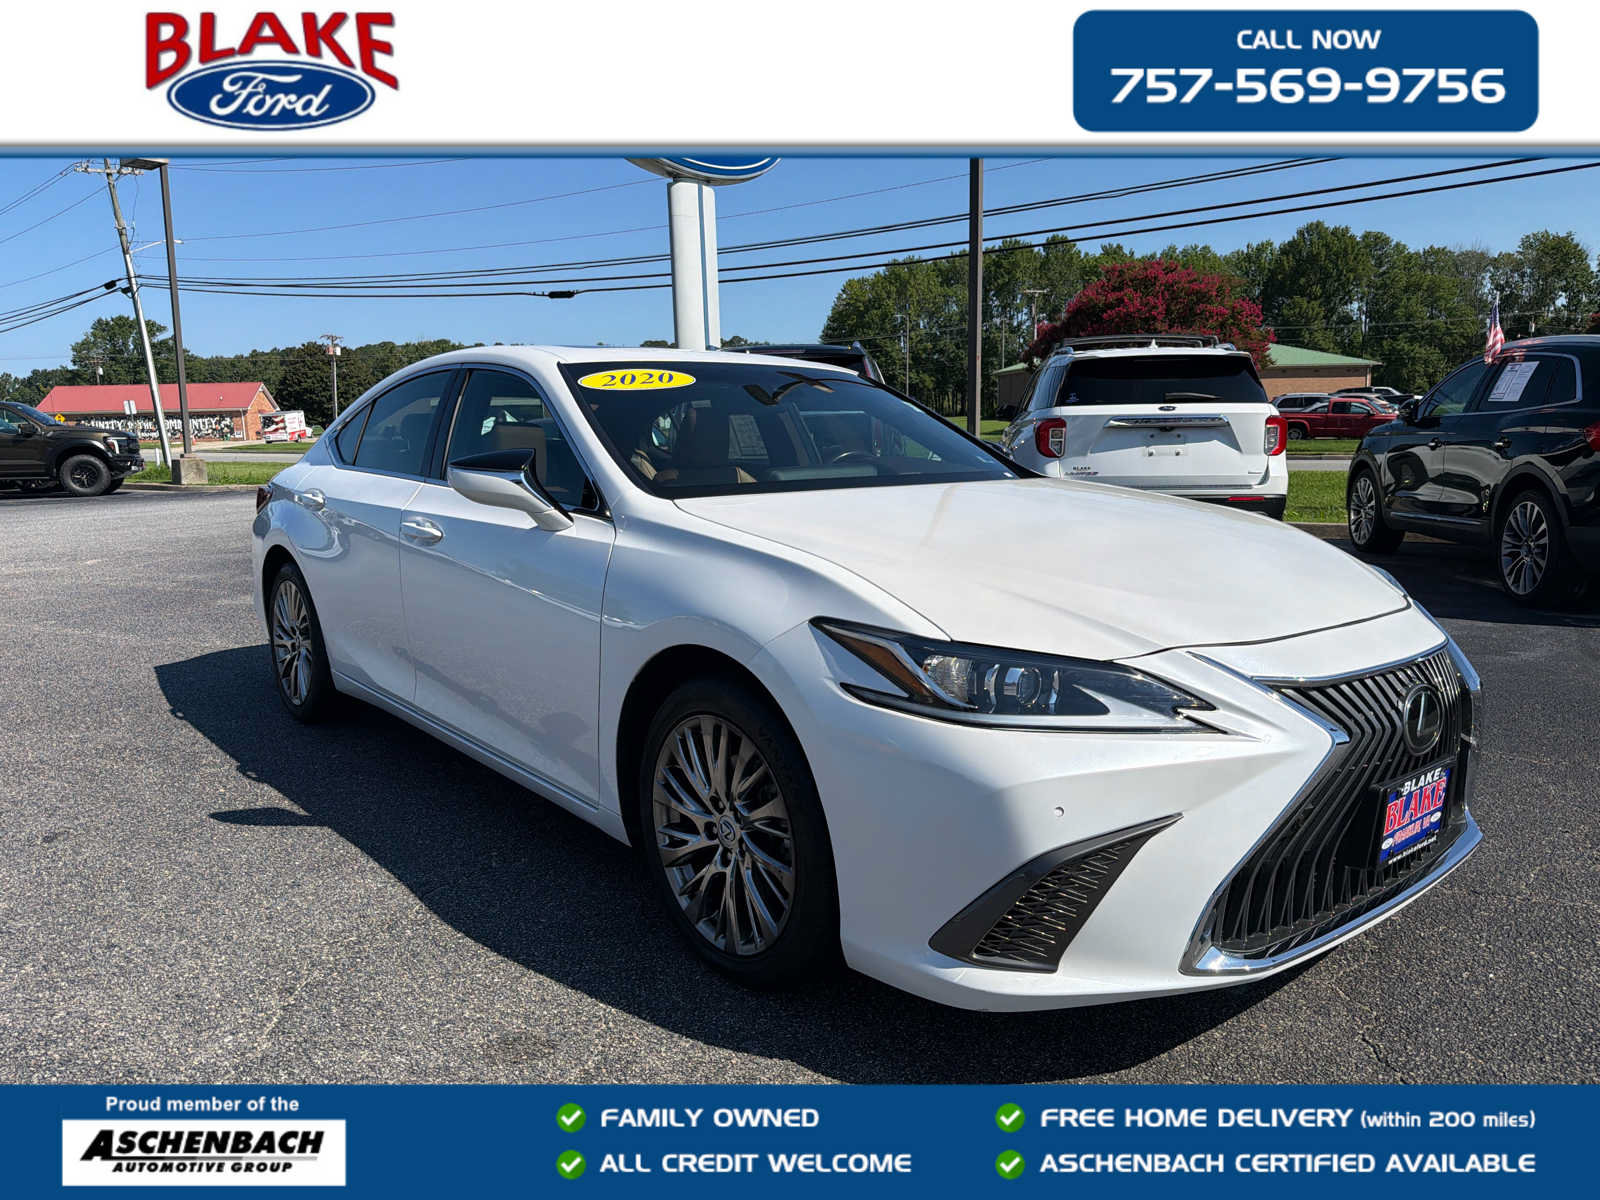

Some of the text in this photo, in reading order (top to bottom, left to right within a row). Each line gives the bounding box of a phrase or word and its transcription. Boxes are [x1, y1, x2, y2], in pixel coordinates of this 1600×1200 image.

[602, 372, 674, 387] 2020
[1402, 768, 1442, 795] BLAKE
[1384, 778, 1446, 836] BLAKE
